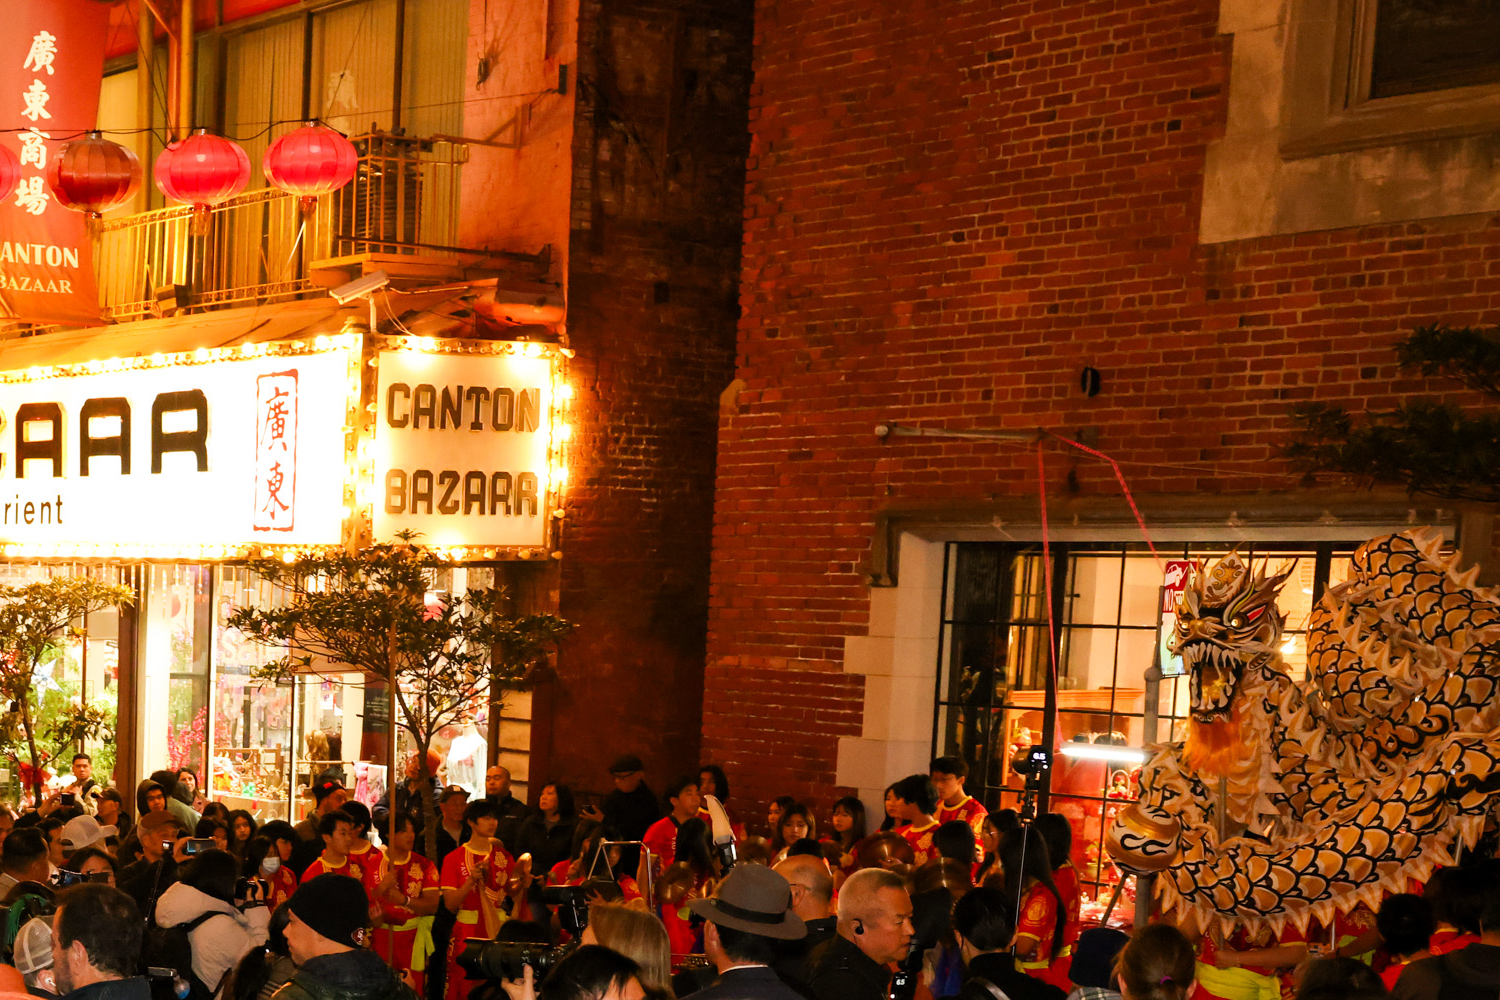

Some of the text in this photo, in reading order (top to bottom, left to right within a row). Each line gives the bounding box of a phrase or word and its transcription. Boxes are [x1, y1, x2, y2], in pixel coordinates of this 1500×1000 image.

[15, 30, 58, 216] 廣東商場
[260, 386, 290, 520] 廣東
[387, 382, 541, 433] CANTON
[384, 469, 540, 517] BAZAAR
